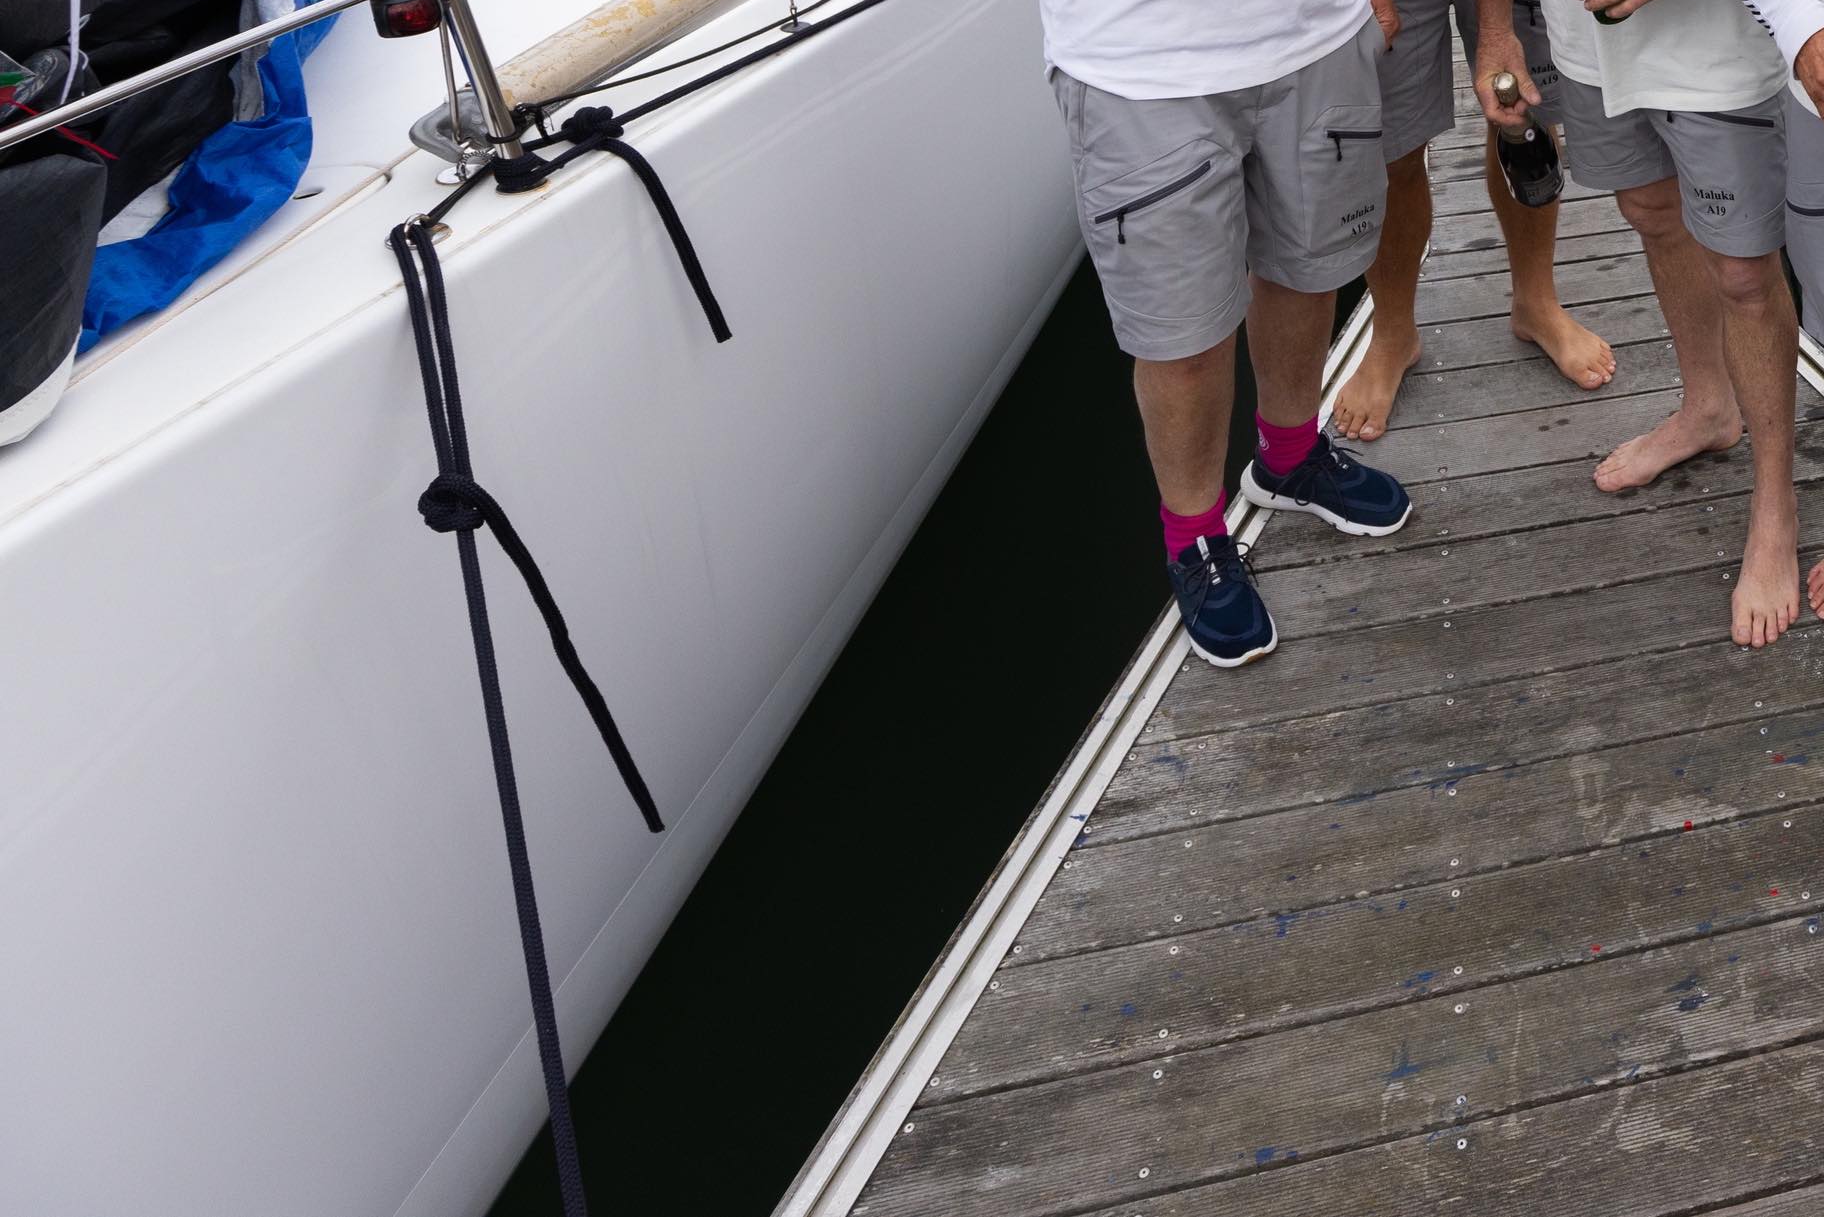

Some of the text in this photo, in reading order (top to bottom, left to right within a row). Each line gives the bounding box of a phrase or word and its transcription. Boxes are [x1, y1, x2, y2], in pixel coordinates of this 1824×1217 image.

[1694, 188, 1735, 201] Maluka
[1341, 204, 1375, 225] Maluka
[1706, 204, 1727, 217] A19
[1352, 220, 1367, 235] A19
